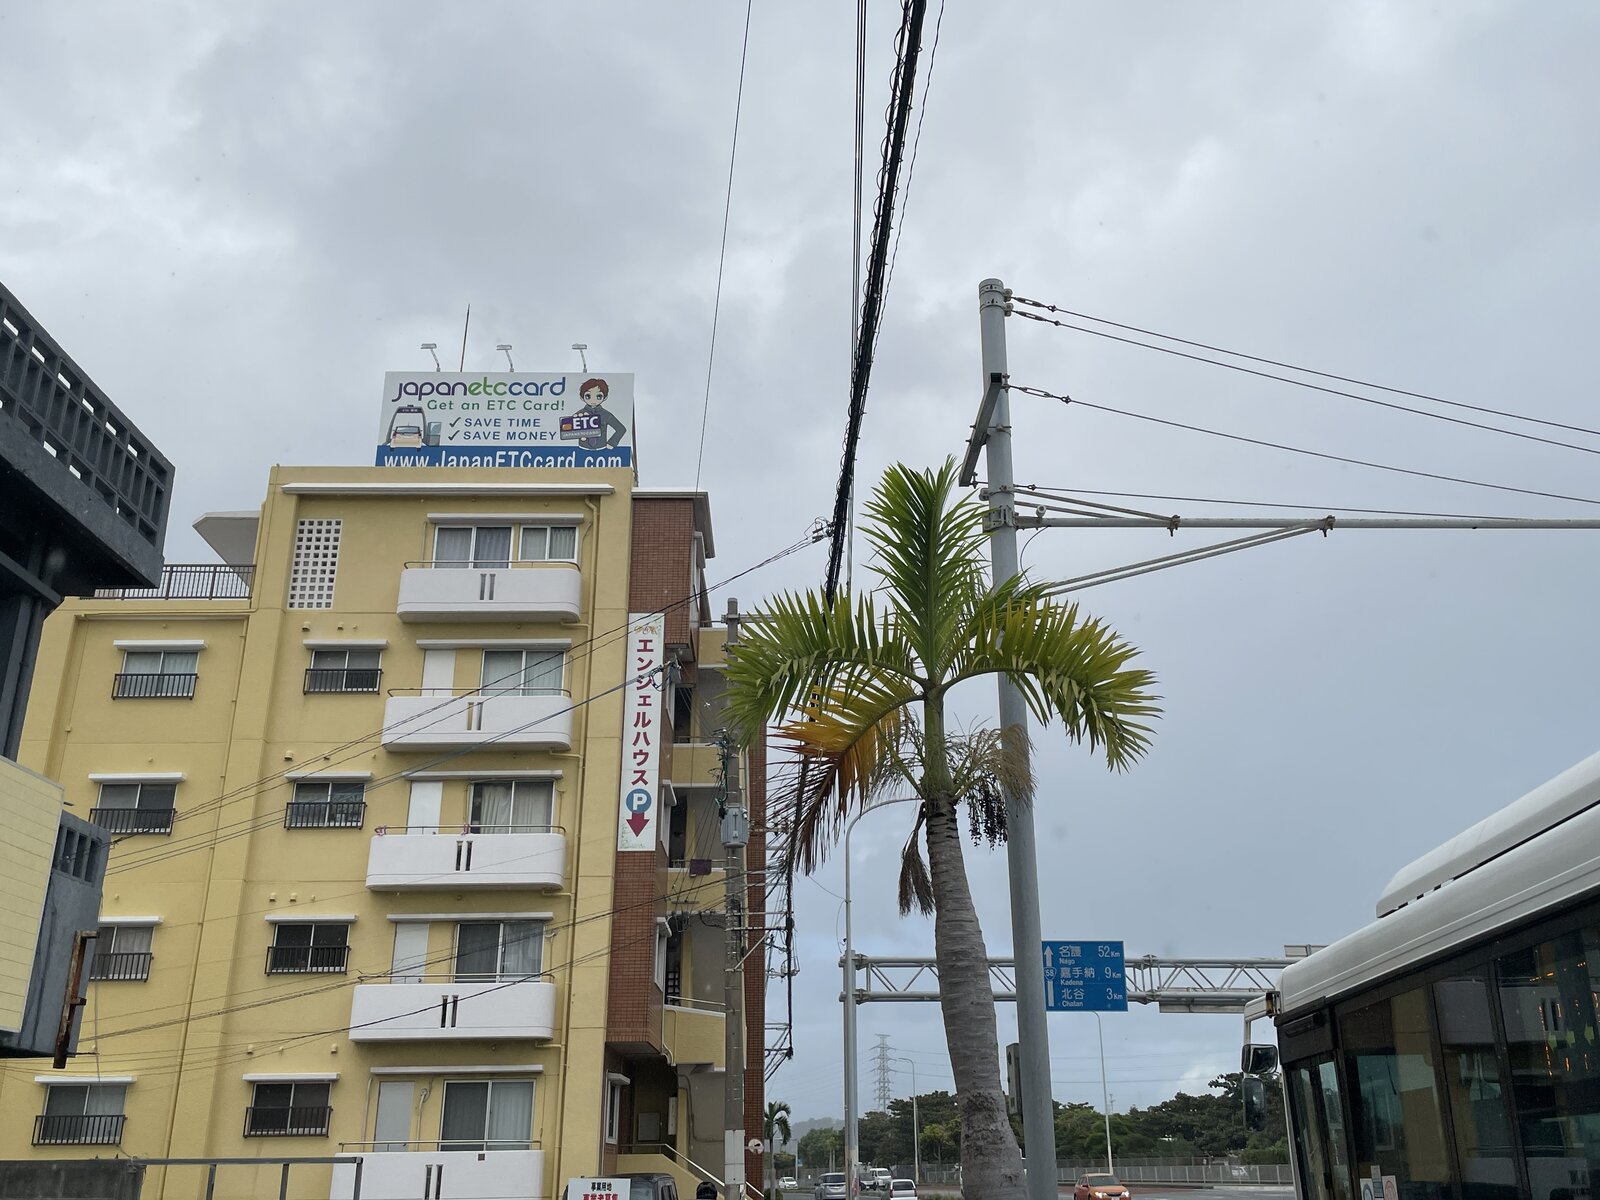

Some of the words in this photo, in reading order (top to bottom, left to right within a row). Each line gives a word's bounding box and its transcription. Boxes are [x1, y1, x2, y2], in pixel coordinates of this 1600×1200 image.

[391, 376, 566, 402] japanetccard
[427, 399, 454, 410] Get
[461, 402, 480, 410] an
[487, 400, 516, 410] ETC
[523, 400, 565, 411] Card!
[464, 418, 502, 427] SAVE
[507, 418, 541, 427] TIME
[572, 416, 599, 430] ETC
[463, 431, 501, 440] SAVE
[506, 431, 557, 440] MONEY
[384, 450, 622, 467] wwwJapanETCcardcom
[632, 793, 648, 811] P
[1061, 988, 1085, 999] 北谷
